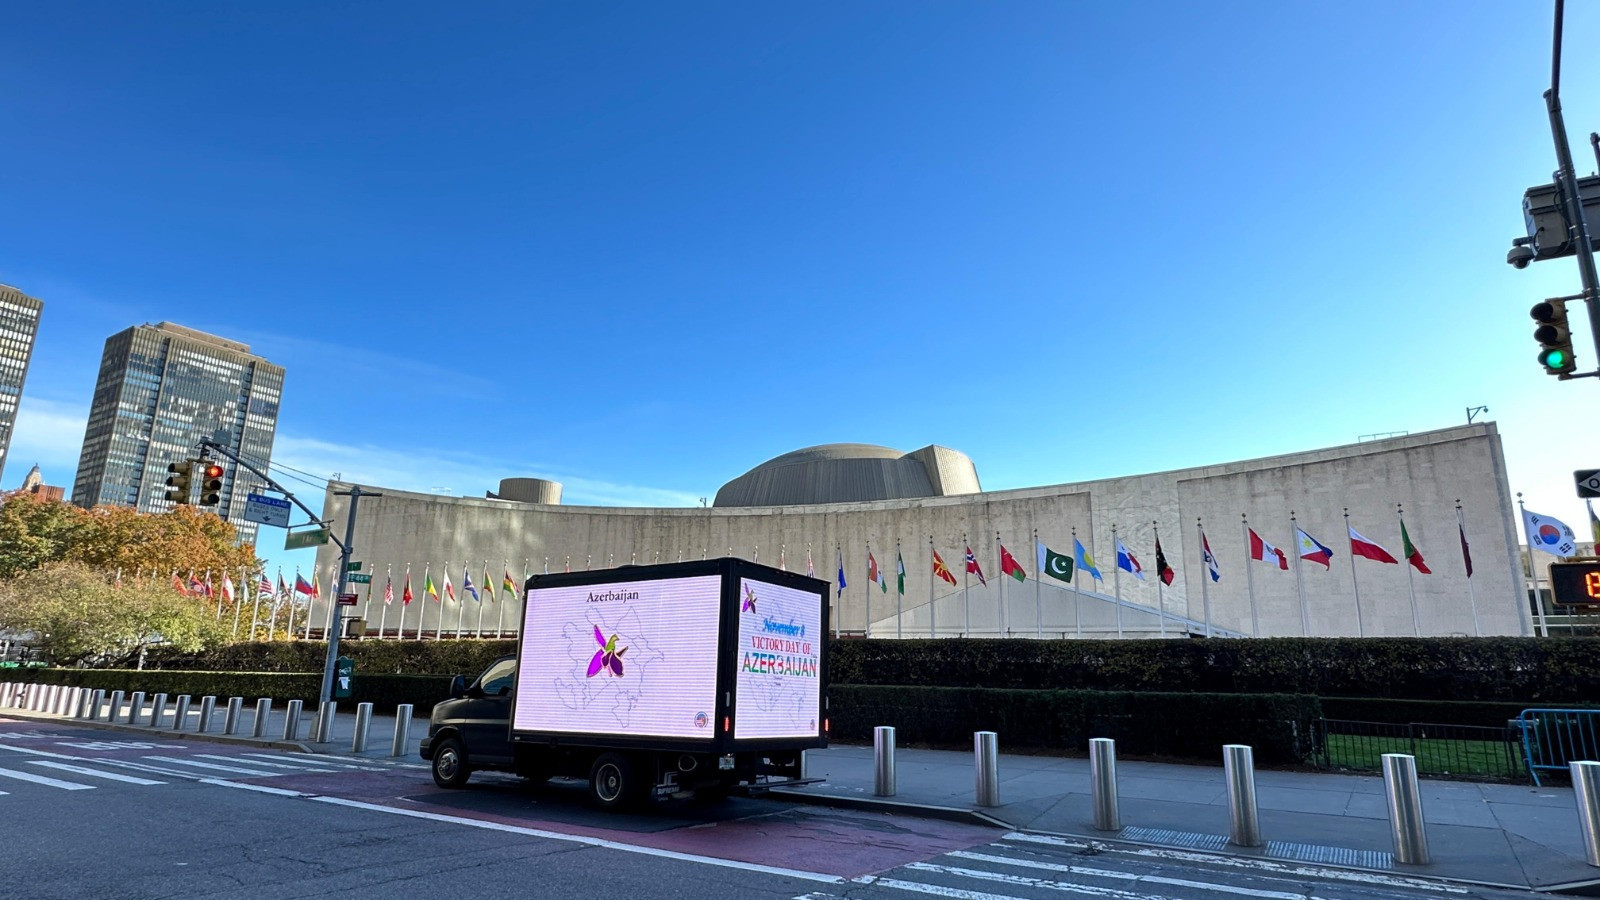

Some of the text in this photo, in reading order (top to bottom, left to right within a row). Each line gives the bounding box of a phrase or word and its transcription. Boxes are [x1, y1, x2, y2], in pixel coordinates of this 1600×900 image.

[253, 502, 269, 510] BUSES
[270, 511, 286, 519] TURNS
[586, 589, 639, 604] Azerbaijan
[762, 615, 806, 638] November 8
[752, 636, 811, 655] VICTORY DAY OF
[742, 651, 817, 677] AZERBAIJAN
